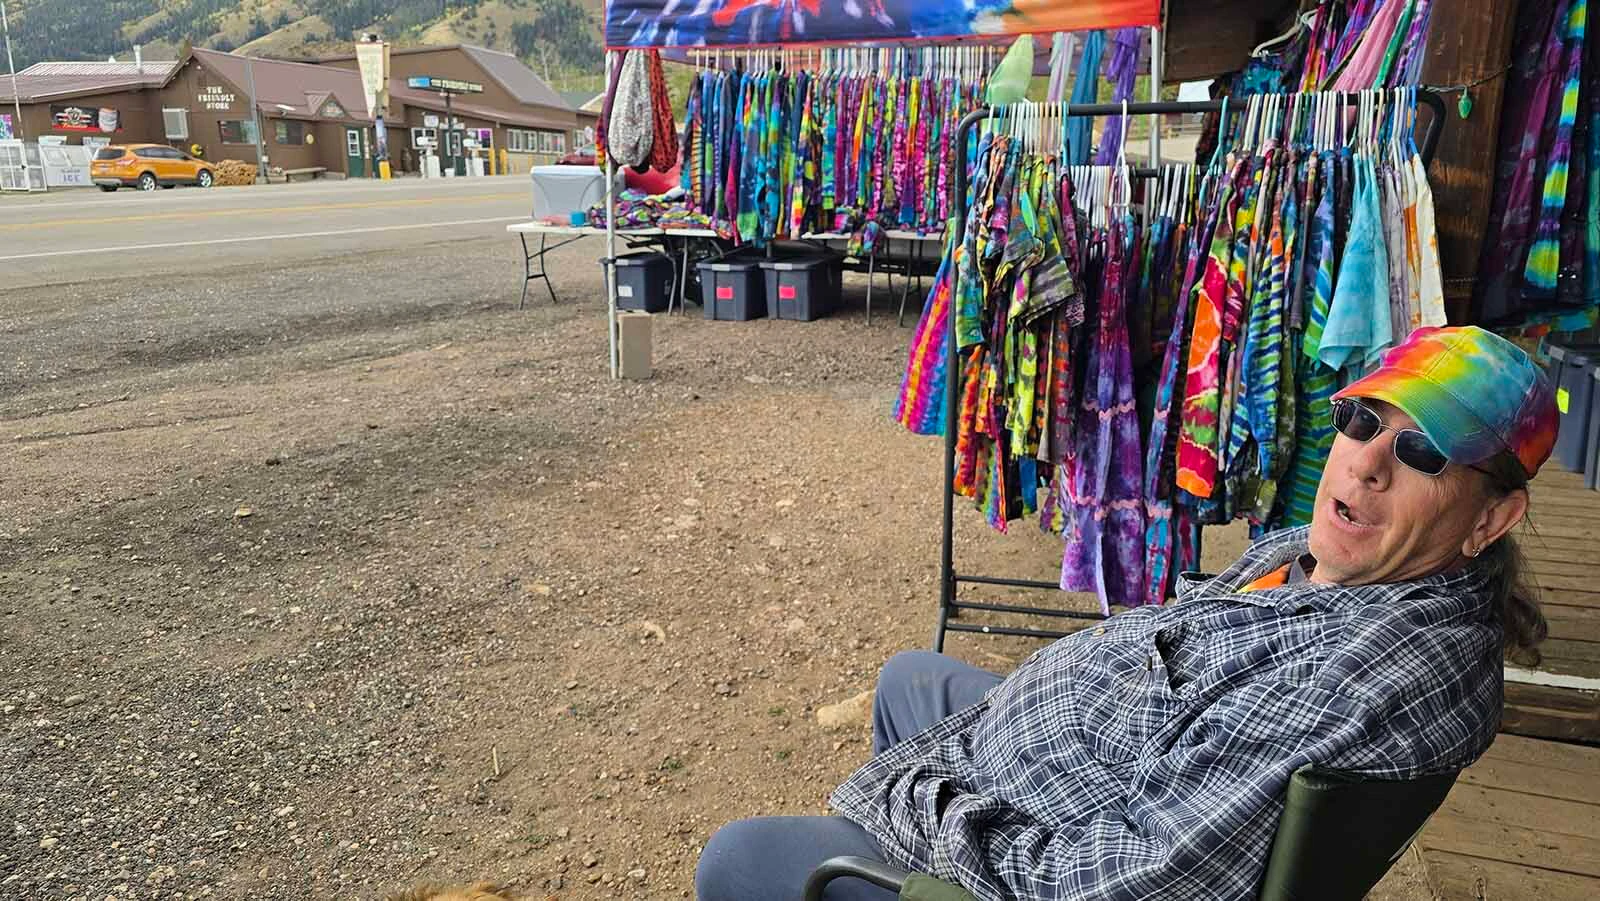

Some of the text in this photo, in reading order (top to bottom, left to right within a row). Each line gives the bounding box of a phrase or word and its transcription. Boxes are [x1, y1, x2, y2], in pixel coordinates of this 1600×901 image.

[207, 86, 223, 94] THE
[198, 94, 235, 103] FRIENDLY
[206, 102, 230, 110] STORE
[63, 174, 81, 183] ICE
